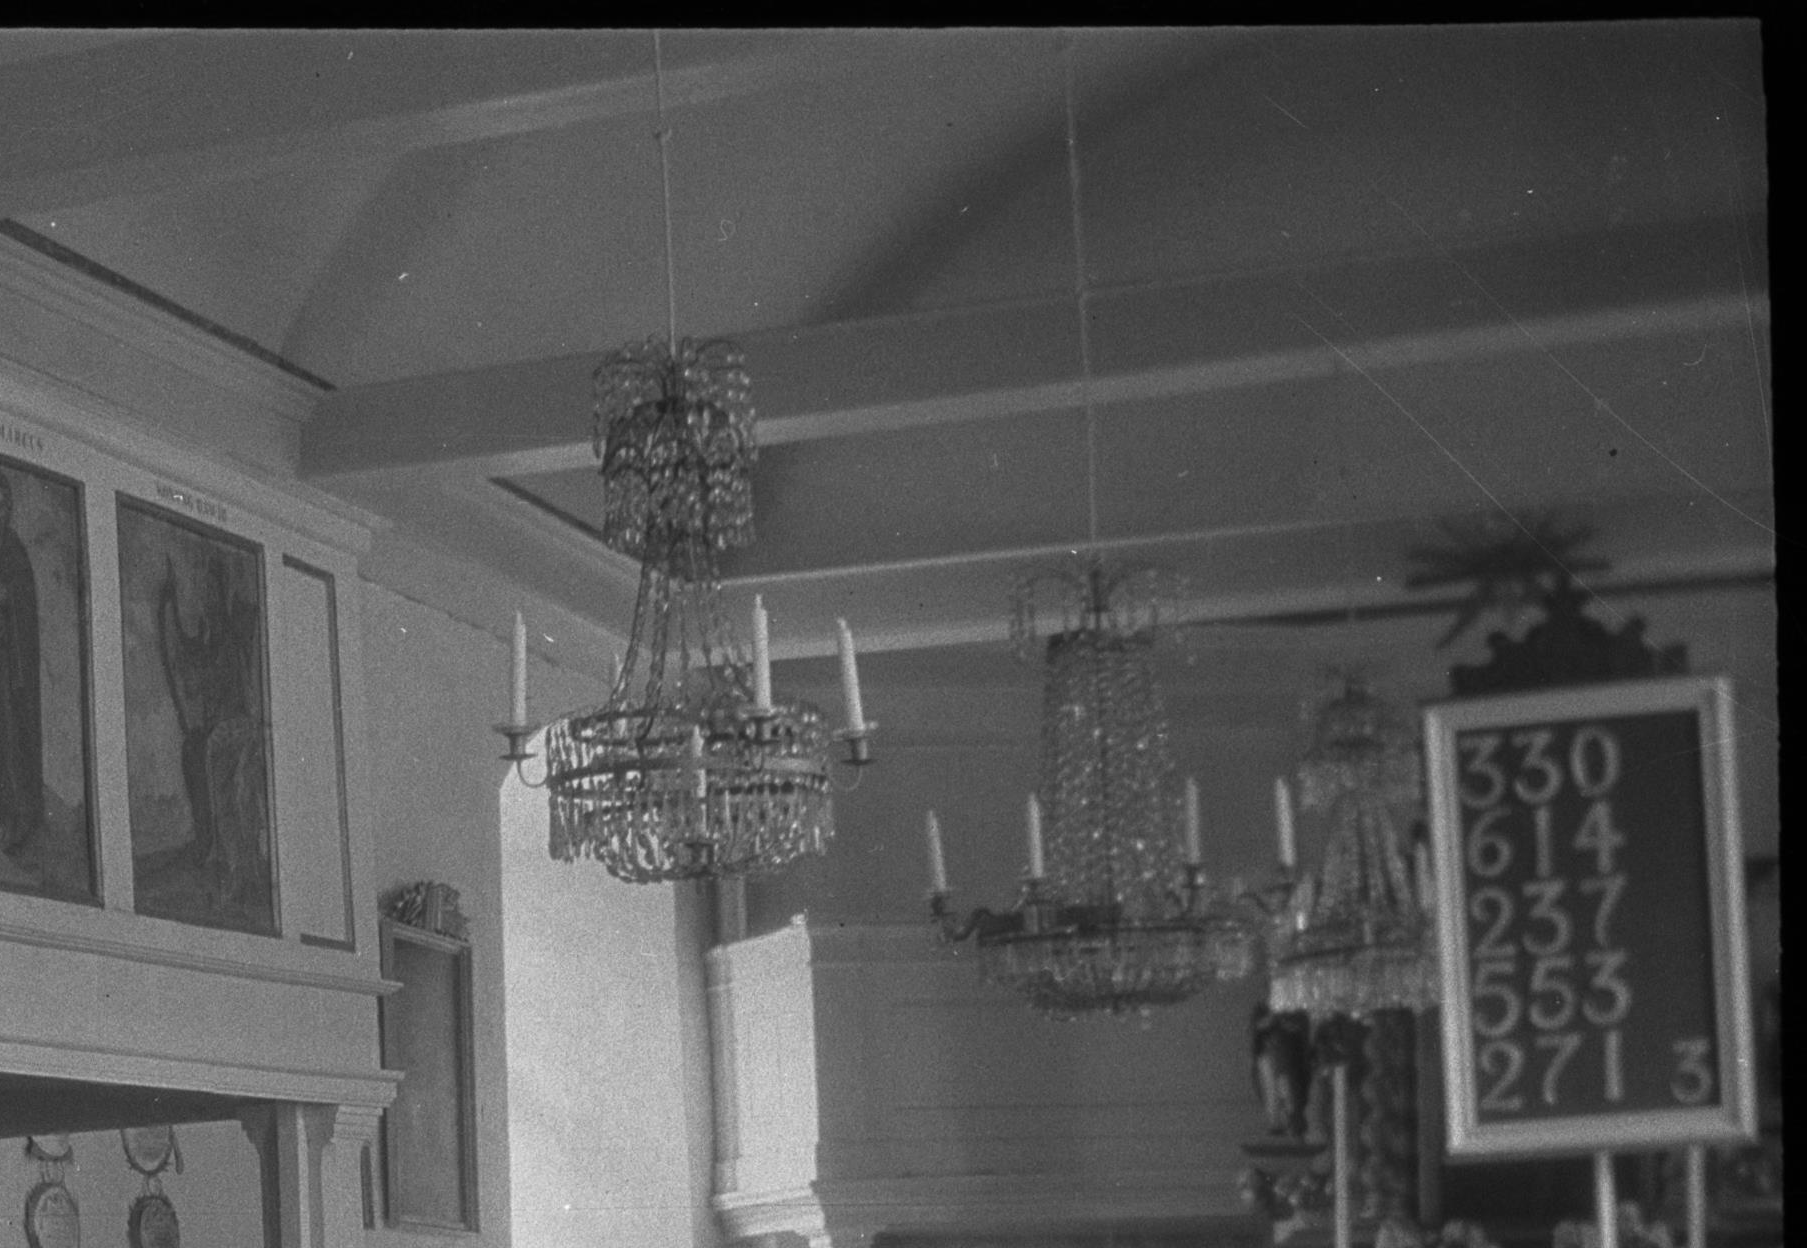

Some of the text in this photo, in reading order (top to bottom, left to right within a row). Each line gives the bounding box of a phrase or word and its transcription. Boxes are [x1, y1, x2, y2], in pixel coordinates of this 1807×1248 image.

[1457, 726, 1620, 807] 330
[1467, 800, 1626, 878] 614
[1471, 872, 1628, 958] 237
[1474, 949, 1632, 1038] 553
[1478, 1029, 1712, 1112] 271 3
